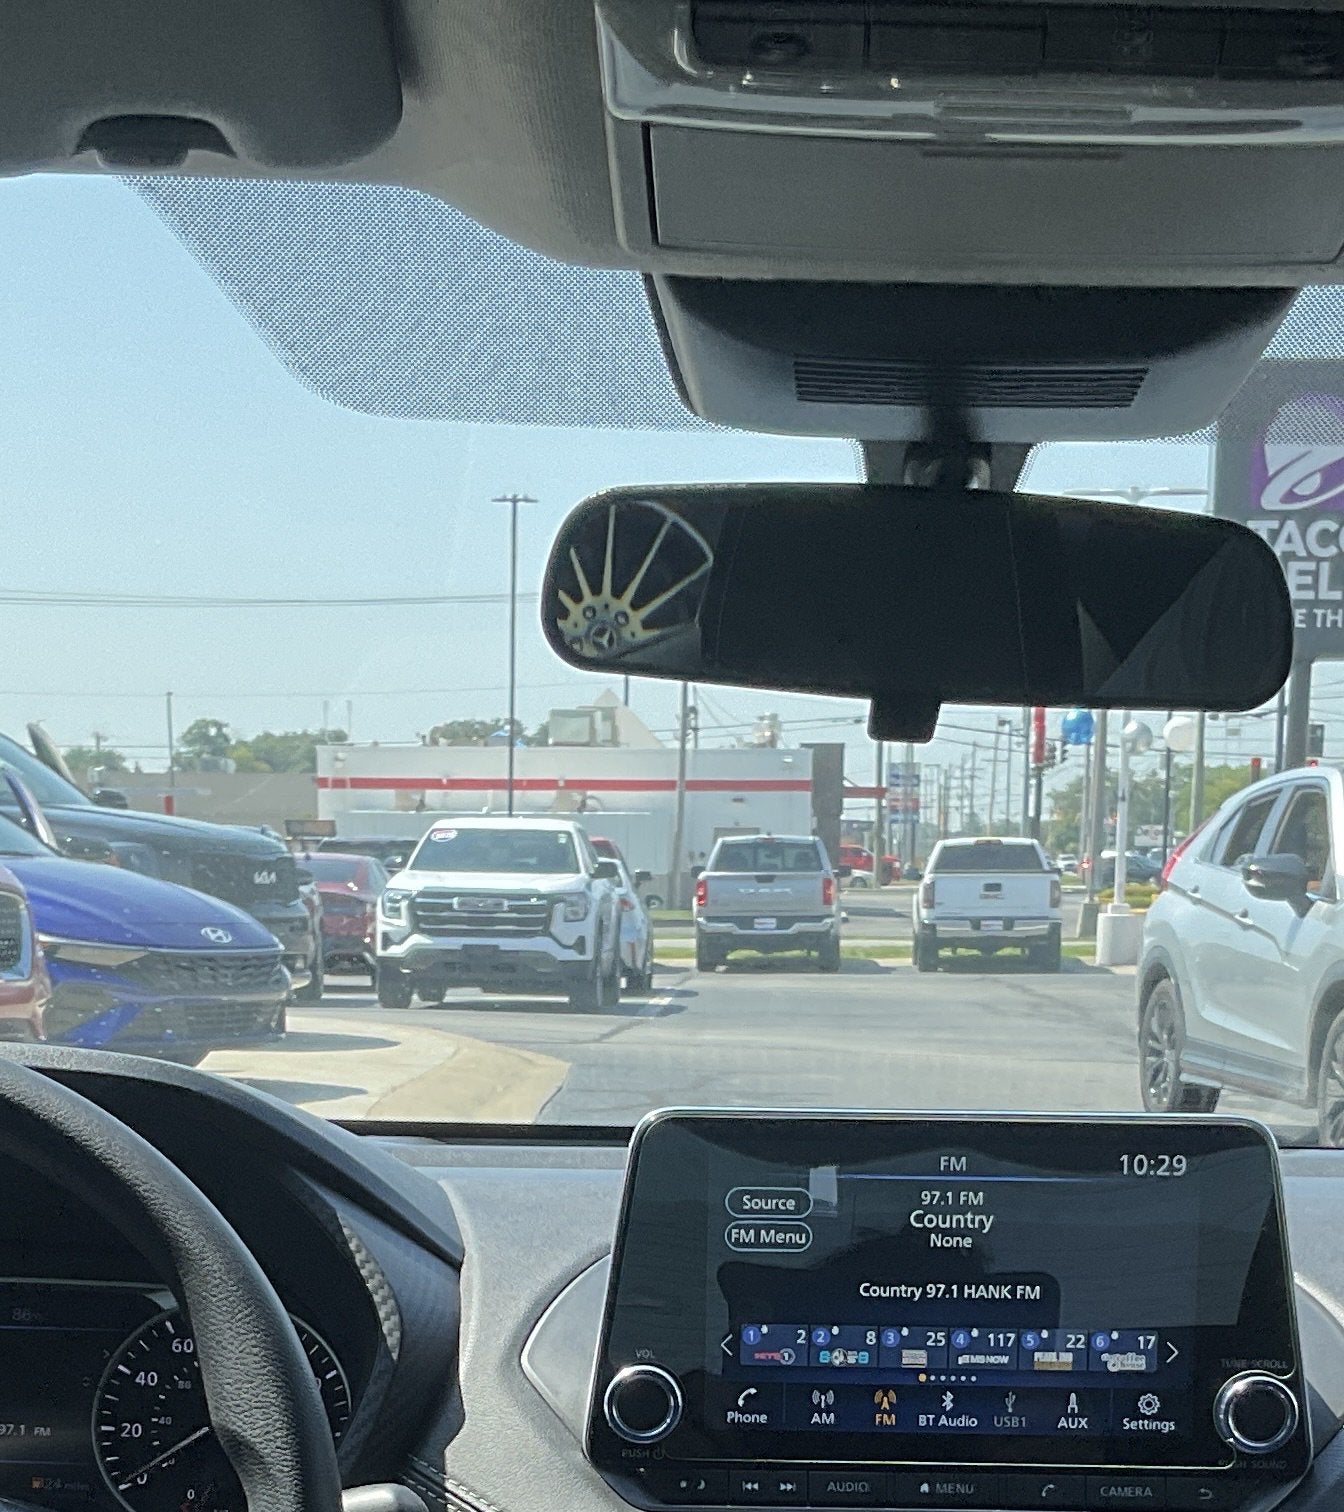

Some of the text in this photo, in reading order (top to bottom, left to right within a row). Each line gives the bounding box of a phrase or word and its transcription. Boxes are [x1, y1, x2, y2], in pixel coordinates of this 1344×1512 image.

[940, 1156, 967, 1171] FM
[1119, 1154, 1187, 1177] 10:29
[742, 1195, 796, 1211] Source
[920, 1191, 984, 1206] 97.1 FM
[910, 1210, 994, 1234] Country
[731, 1228, 806, 1245] FM Menu
[930, 1233, 973, 1249] None
[859, 1283, 1041, 1302] Country 97.1 HANK FM
[796, 1329, 806, 1345] 2
[865, 1331, 877, 1346] 8
[926, 1332, 946, 1347] 25
[988, 1333, 1016, 1348] 117
[1066, 1334, 1086, 1349] 22
[1137, 1335, 1156, 1350] 17
[172, 1338, 193, 1353] 60
[635, 1350, 655, 1359] VOL
[135, 1371, 157, 1386] 40
[159, 1416, 172, 1425] 40
[726, 1411, 767, 1424] Phone
[811, 1413, 835, 1425] AM
[875, 1414, 896, 1426] FM
[918, 1414, 978, 1427] BT Audio
[994, 1416, 1026, 1428] USB1
[1058, 1418, 1088, 1429] AUX
[34, 1427, 51, 1436] FM
[120, 1423, 143, 1438] 20
[1123, 1418, 1175, 1433] Settings
[827, 1481, 869, 1493] AUDIO
[936, 1482, 974, 1494] MENU
[1101, 1486, 1152, 1497] CAMERA
